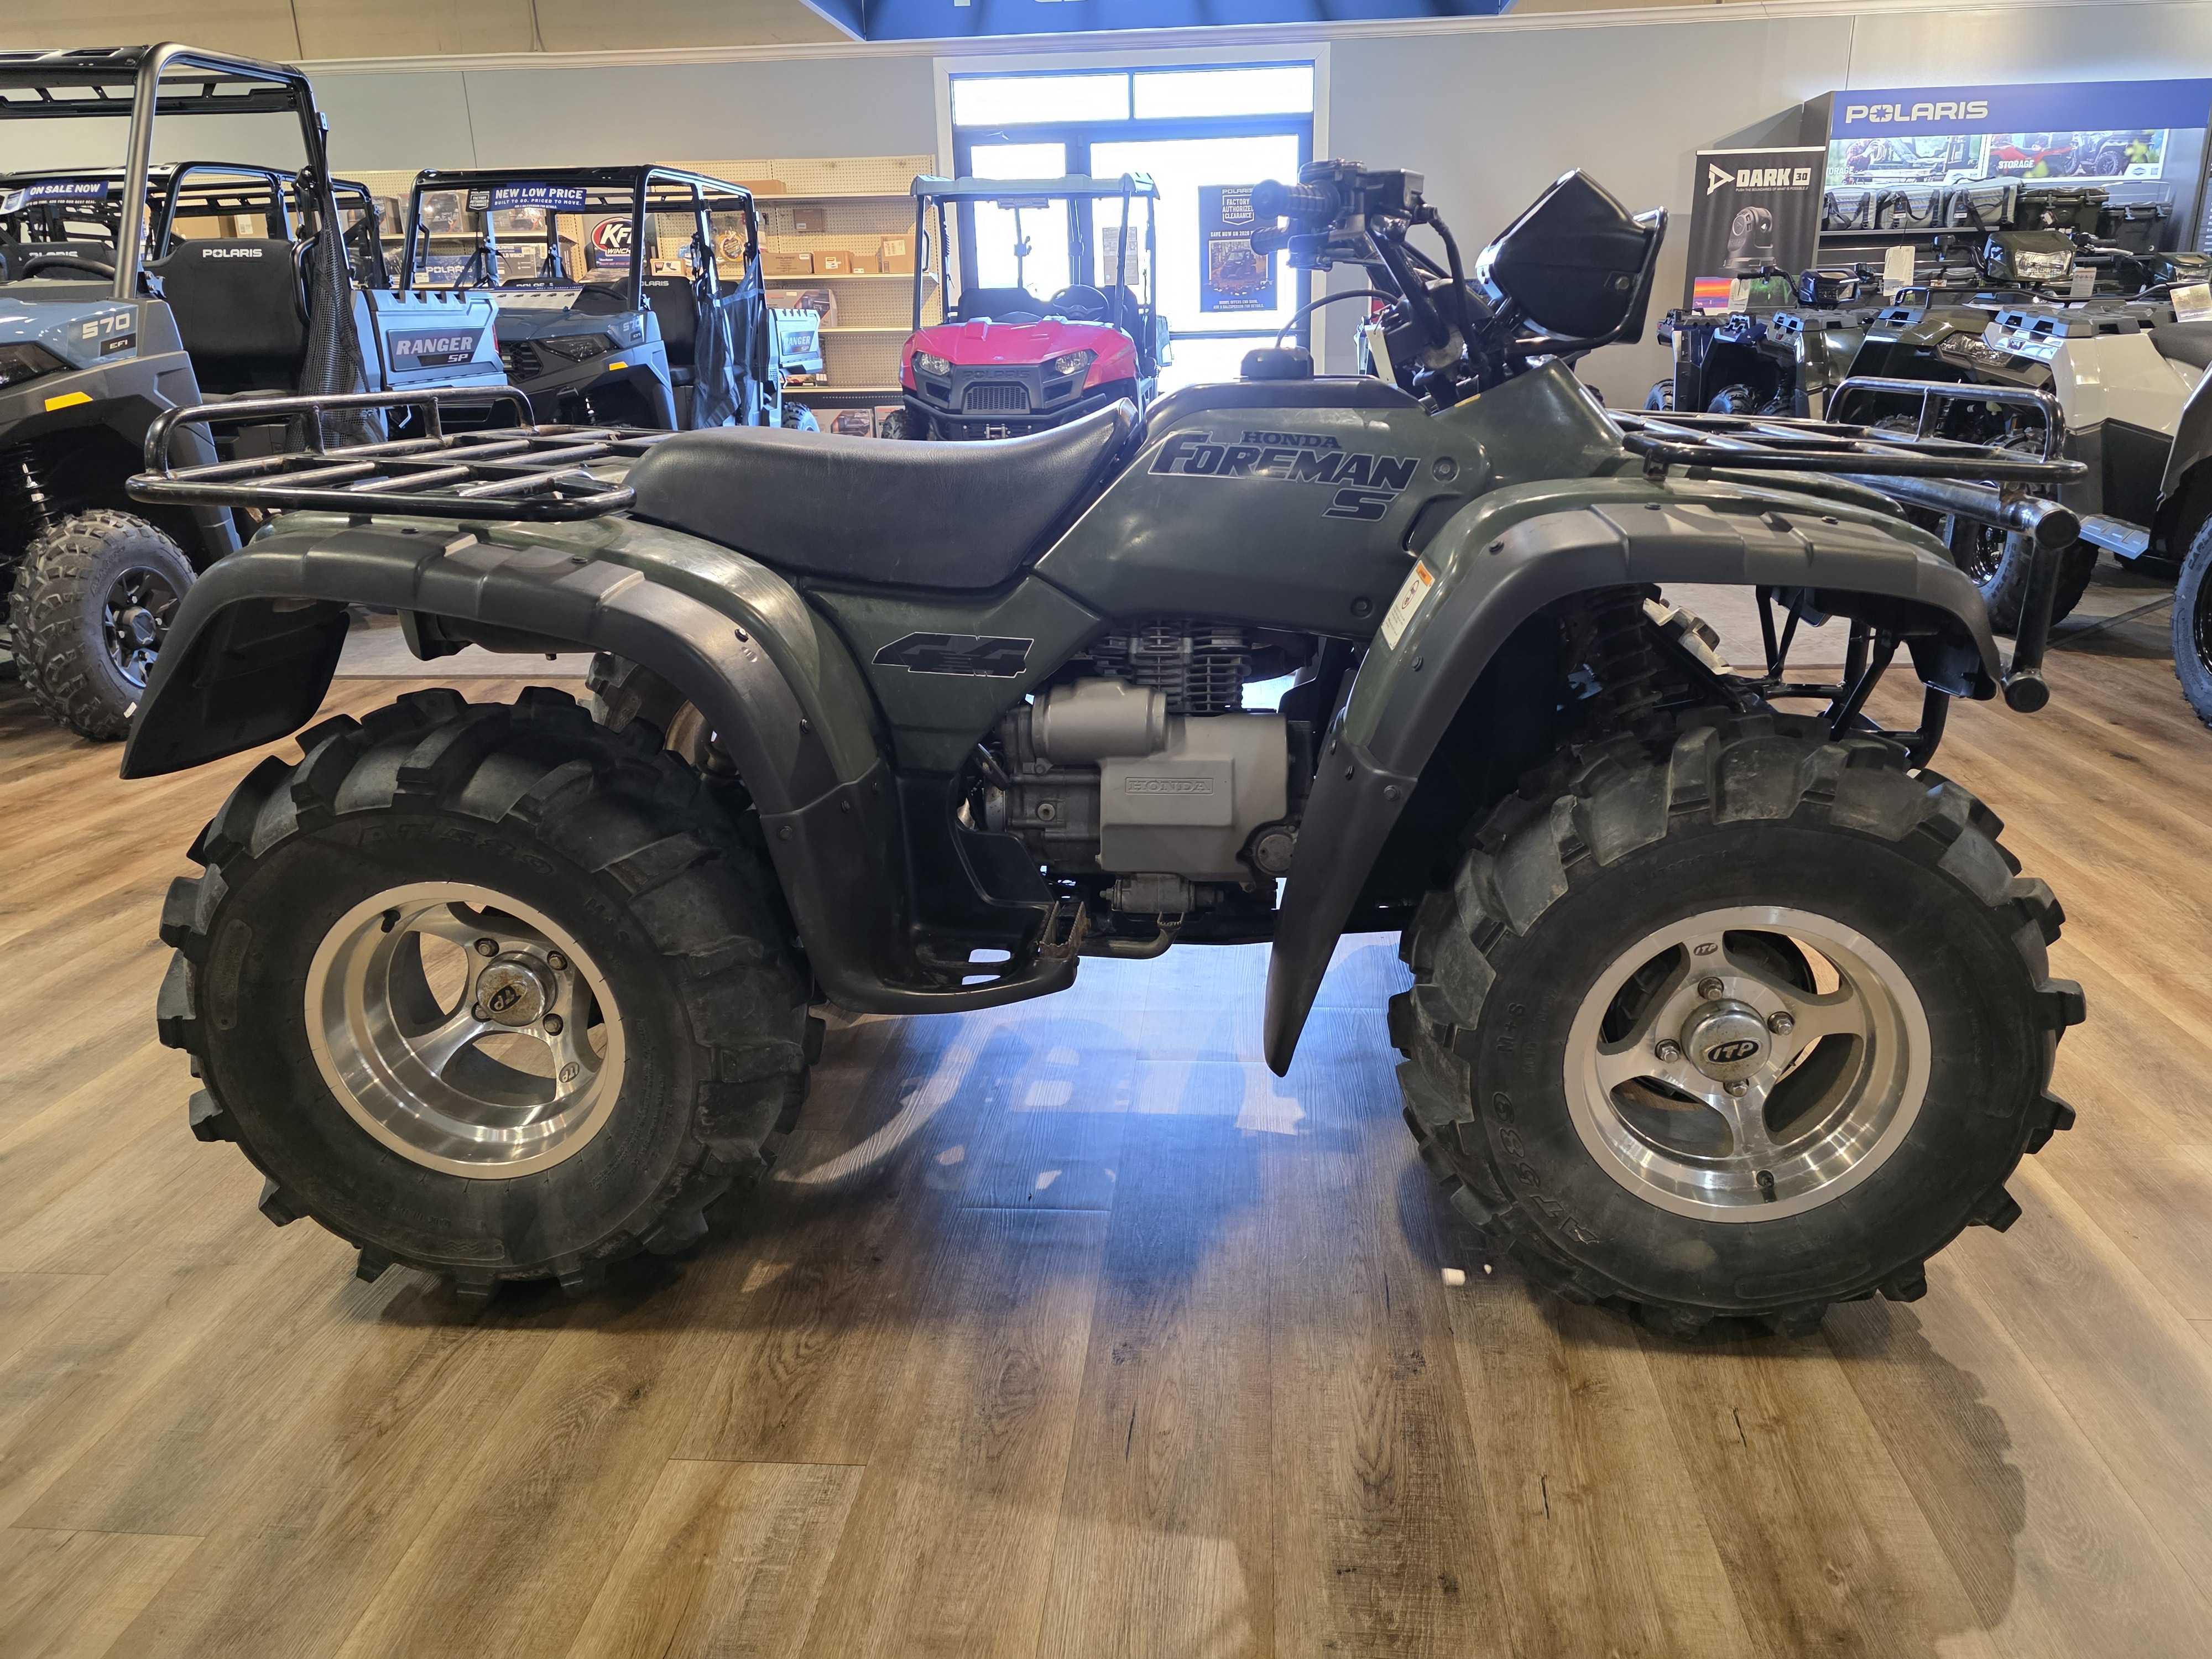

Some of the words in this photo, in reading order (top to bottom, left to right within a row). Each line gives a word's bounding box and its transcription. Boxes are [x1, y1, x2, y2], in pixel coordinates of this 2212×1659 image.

[1845, 101, 1988, 123] POLARIS
[1826, 166, 1855, 175] TORAGE
[1998, 159, 2034, 169] STORAGE
[1736, 168, 1791, 187] DARK
[1796, 173, 1808, 181] 30
[30, 186, 44, 195] ON
[45, 185, 74, 194] SALE
[75, 184, 101, 193] NOW
[495, 189, 520, 199] NEW
[522, 188, 547, 197] LOW
[549, 188, 583, 199] PRICE
[202, 248, 263, 258] POLARIS
[82, 313, 130, 339] 570
[109, 340, 128, 349] EFI
[396, 336, 473, 356] RANGER
[447, 353, 468, 363] SP
[1242, 431, 1342, 449] HONDA
[1322, 488, 1400, 521] S
[1128, 780, 1211, 792] HONDA
[1695, 943, 1718, 956] ITP
[1713, 1042, 1754, 1060] ITP
[562, 1065, 579, 1083] ITP
